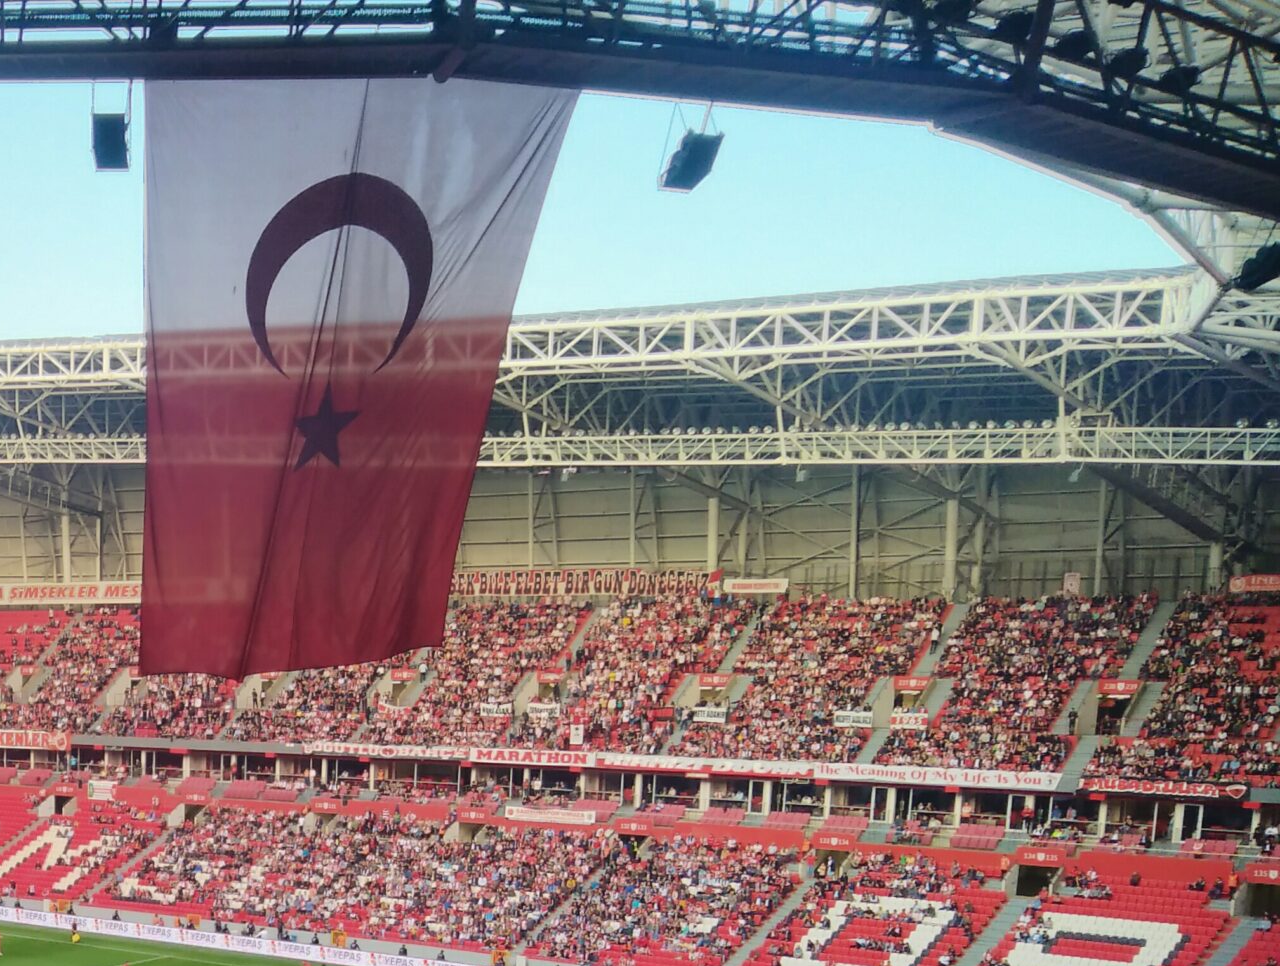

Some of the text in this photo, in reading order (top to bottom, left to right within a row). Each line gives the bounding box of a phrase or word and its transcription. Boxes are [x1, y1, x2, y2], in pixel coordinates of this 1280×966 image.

[514, 571, 561, 595] ELBET
[476, 748, 588, 765] MARATHON
[816, 762, 841, 776] The
[931, 769, 957, 784] My
[1013, 772, 1042, 786] You
